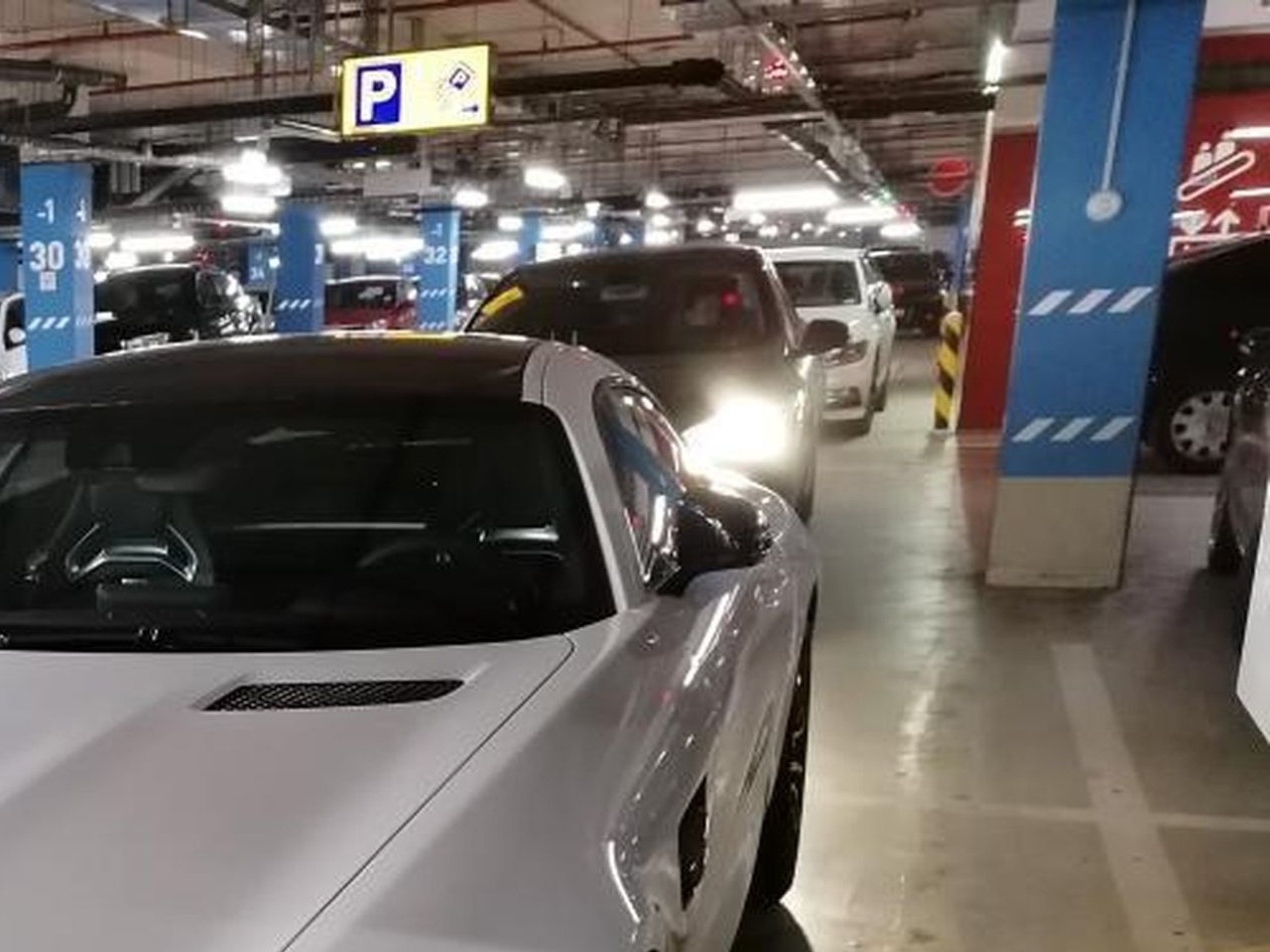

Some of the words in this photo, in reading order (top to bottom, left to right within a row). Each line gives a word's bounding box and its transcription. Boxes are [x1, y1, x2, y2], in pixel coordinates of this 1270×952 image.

[360, 67, 398, 122] P
[36, 198, 55, 223] -1
[29, 240, 65, 270] 30
